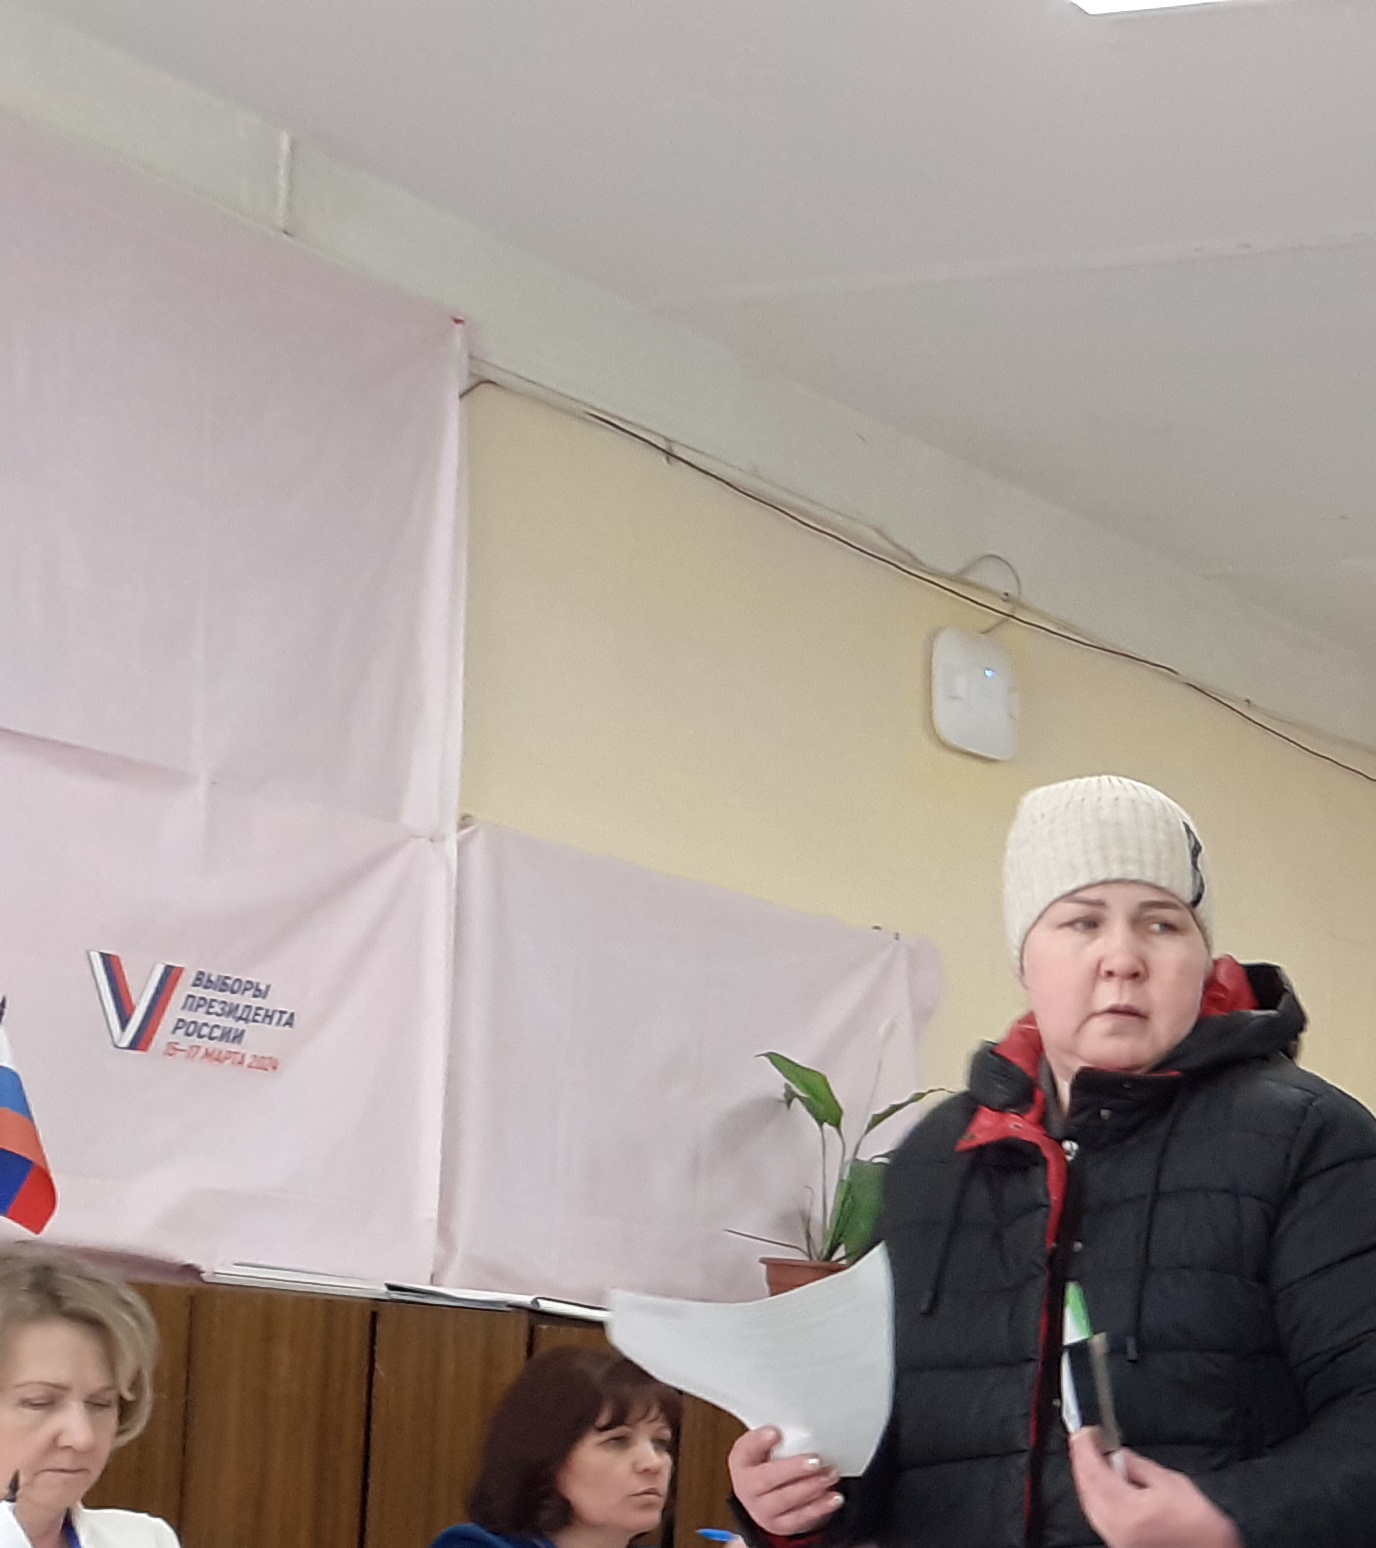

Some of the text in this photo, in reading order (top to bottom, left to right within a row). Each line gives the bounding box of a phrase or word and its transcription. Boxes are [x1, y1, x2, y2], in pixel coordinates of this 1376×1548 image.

[191, 970, 271, 999] ВЫБОРЫ
[181, 994, 295, 1028] ПРЕЗИДЕНТА
[172, 1018, 246, 1045] РОССИИ
